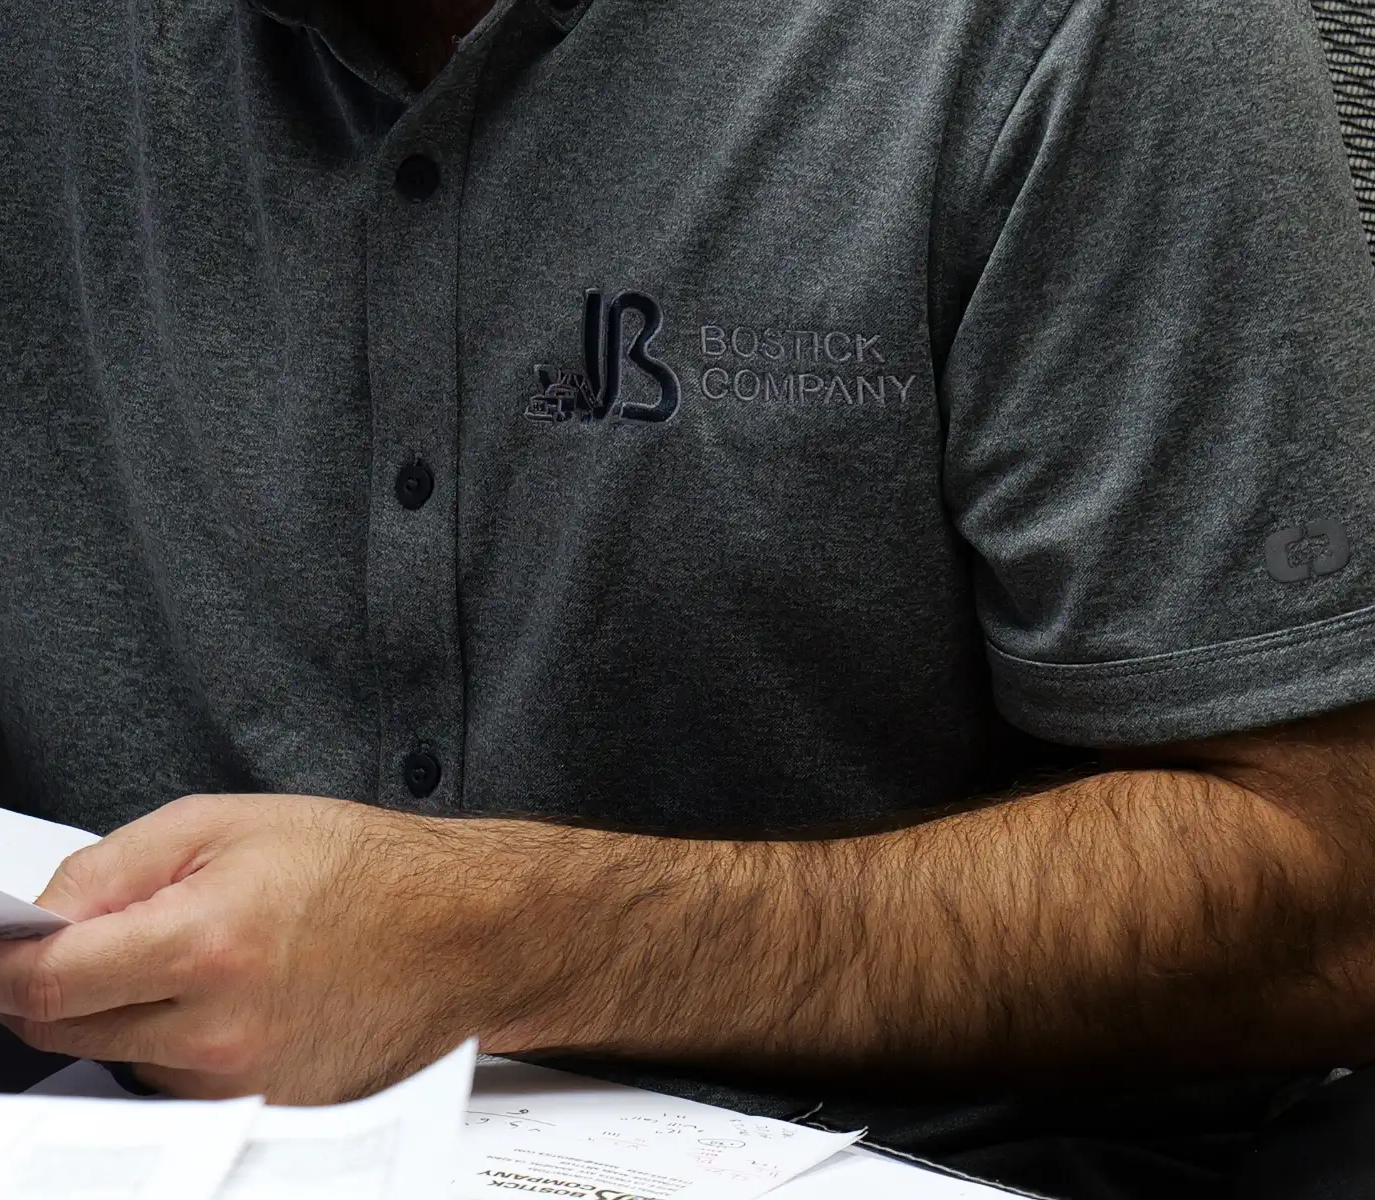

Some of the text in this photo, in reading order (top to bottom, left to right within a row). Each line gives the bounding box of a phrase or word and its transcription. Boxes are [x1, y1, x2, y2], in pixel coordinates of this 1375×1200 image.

[700, 324, 885, 364] BOSTICK
[700, 368, 917, 406] COMPANY
[478, 1169, 597, 1192] COMPANY
[487, 1179, 587, 1199] BOSTICK
